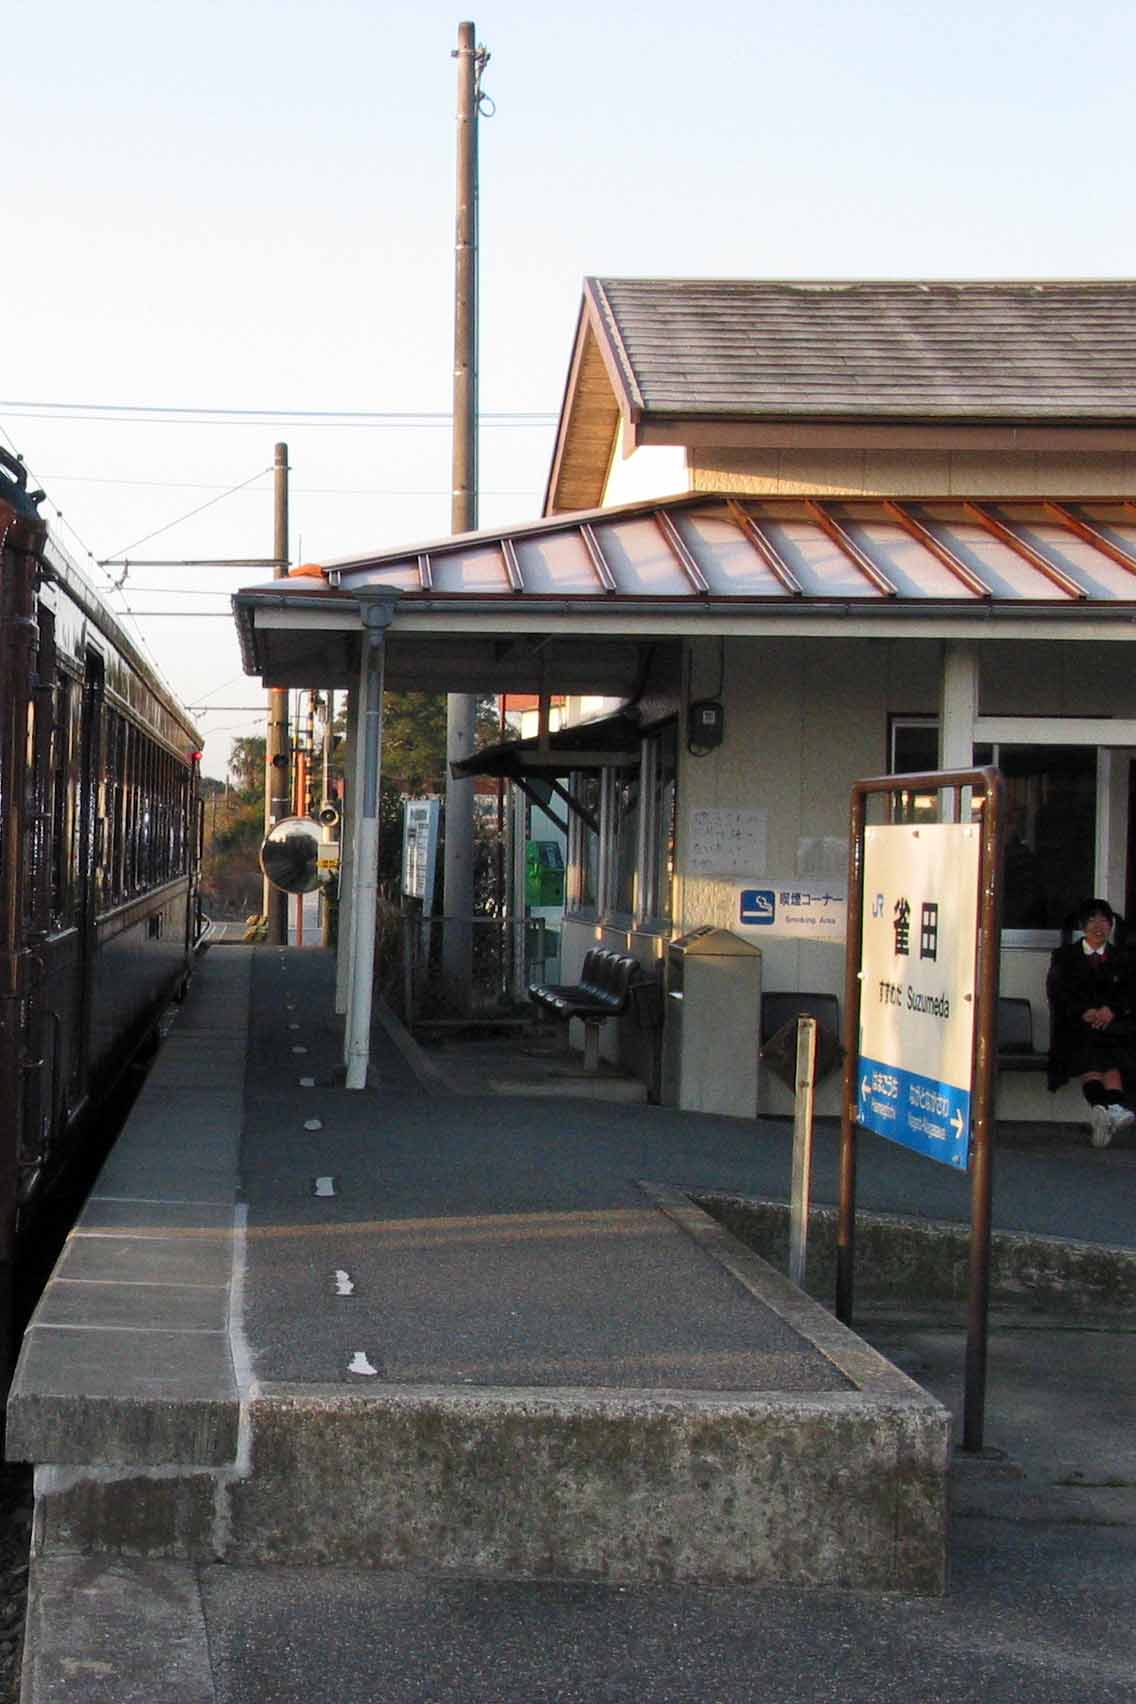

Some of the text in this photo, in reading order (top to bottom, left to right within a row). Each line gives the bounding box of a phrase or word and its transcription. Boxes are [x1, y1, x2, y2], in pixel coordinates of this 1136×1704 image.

[779, 891, 844, 907] 喫煙コーナー
[893, 897, 939, 963] 雀田
[906, 985, 950, 1019] Suzumeda
